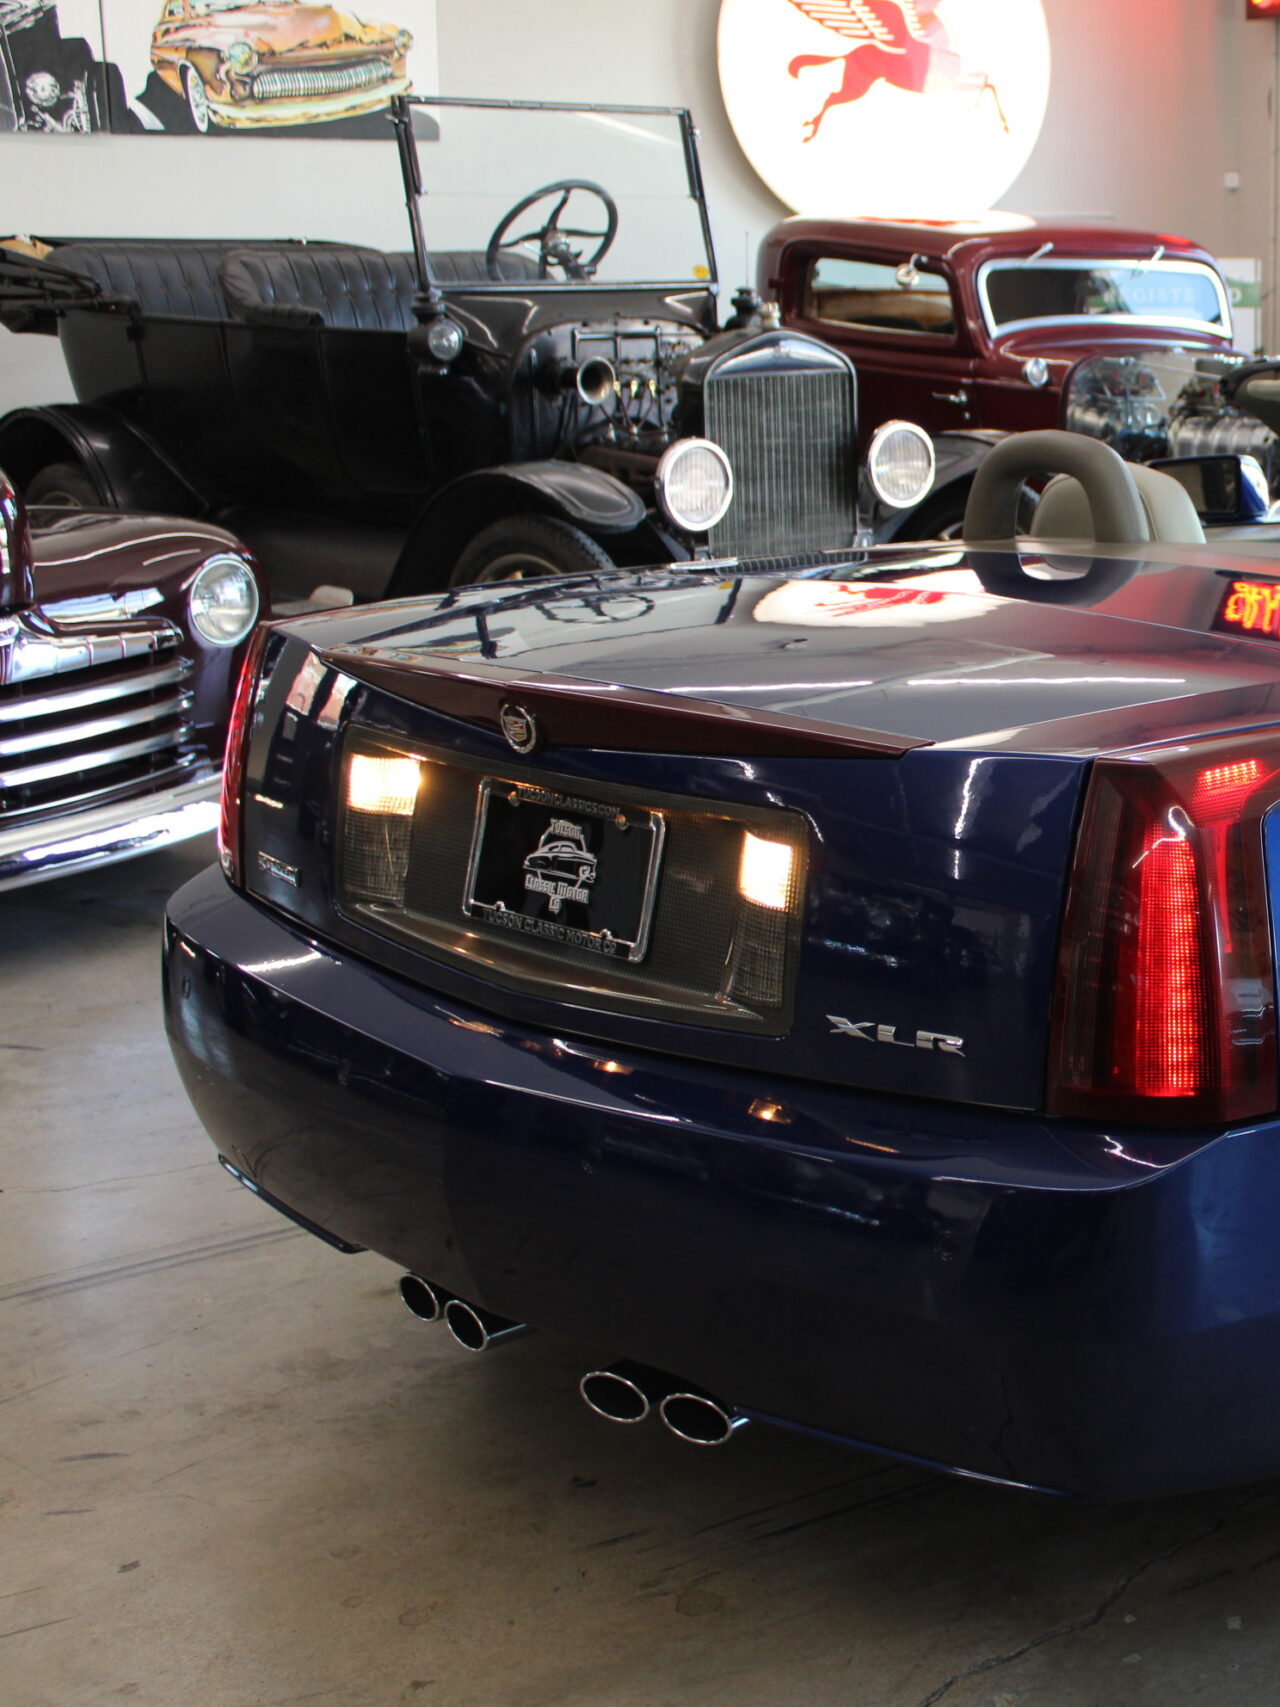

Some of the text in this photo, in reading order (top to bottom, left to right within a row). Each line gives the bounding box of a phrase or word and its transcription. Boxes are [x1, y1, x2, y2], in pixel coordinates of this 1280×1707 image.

[484, 910, 523, 930] TUCSON
[524, 919, 564, 940] CLASSIC
[567, 930, 602, 950] MOTOR
[825, 1014, 966, 1058] XLR
